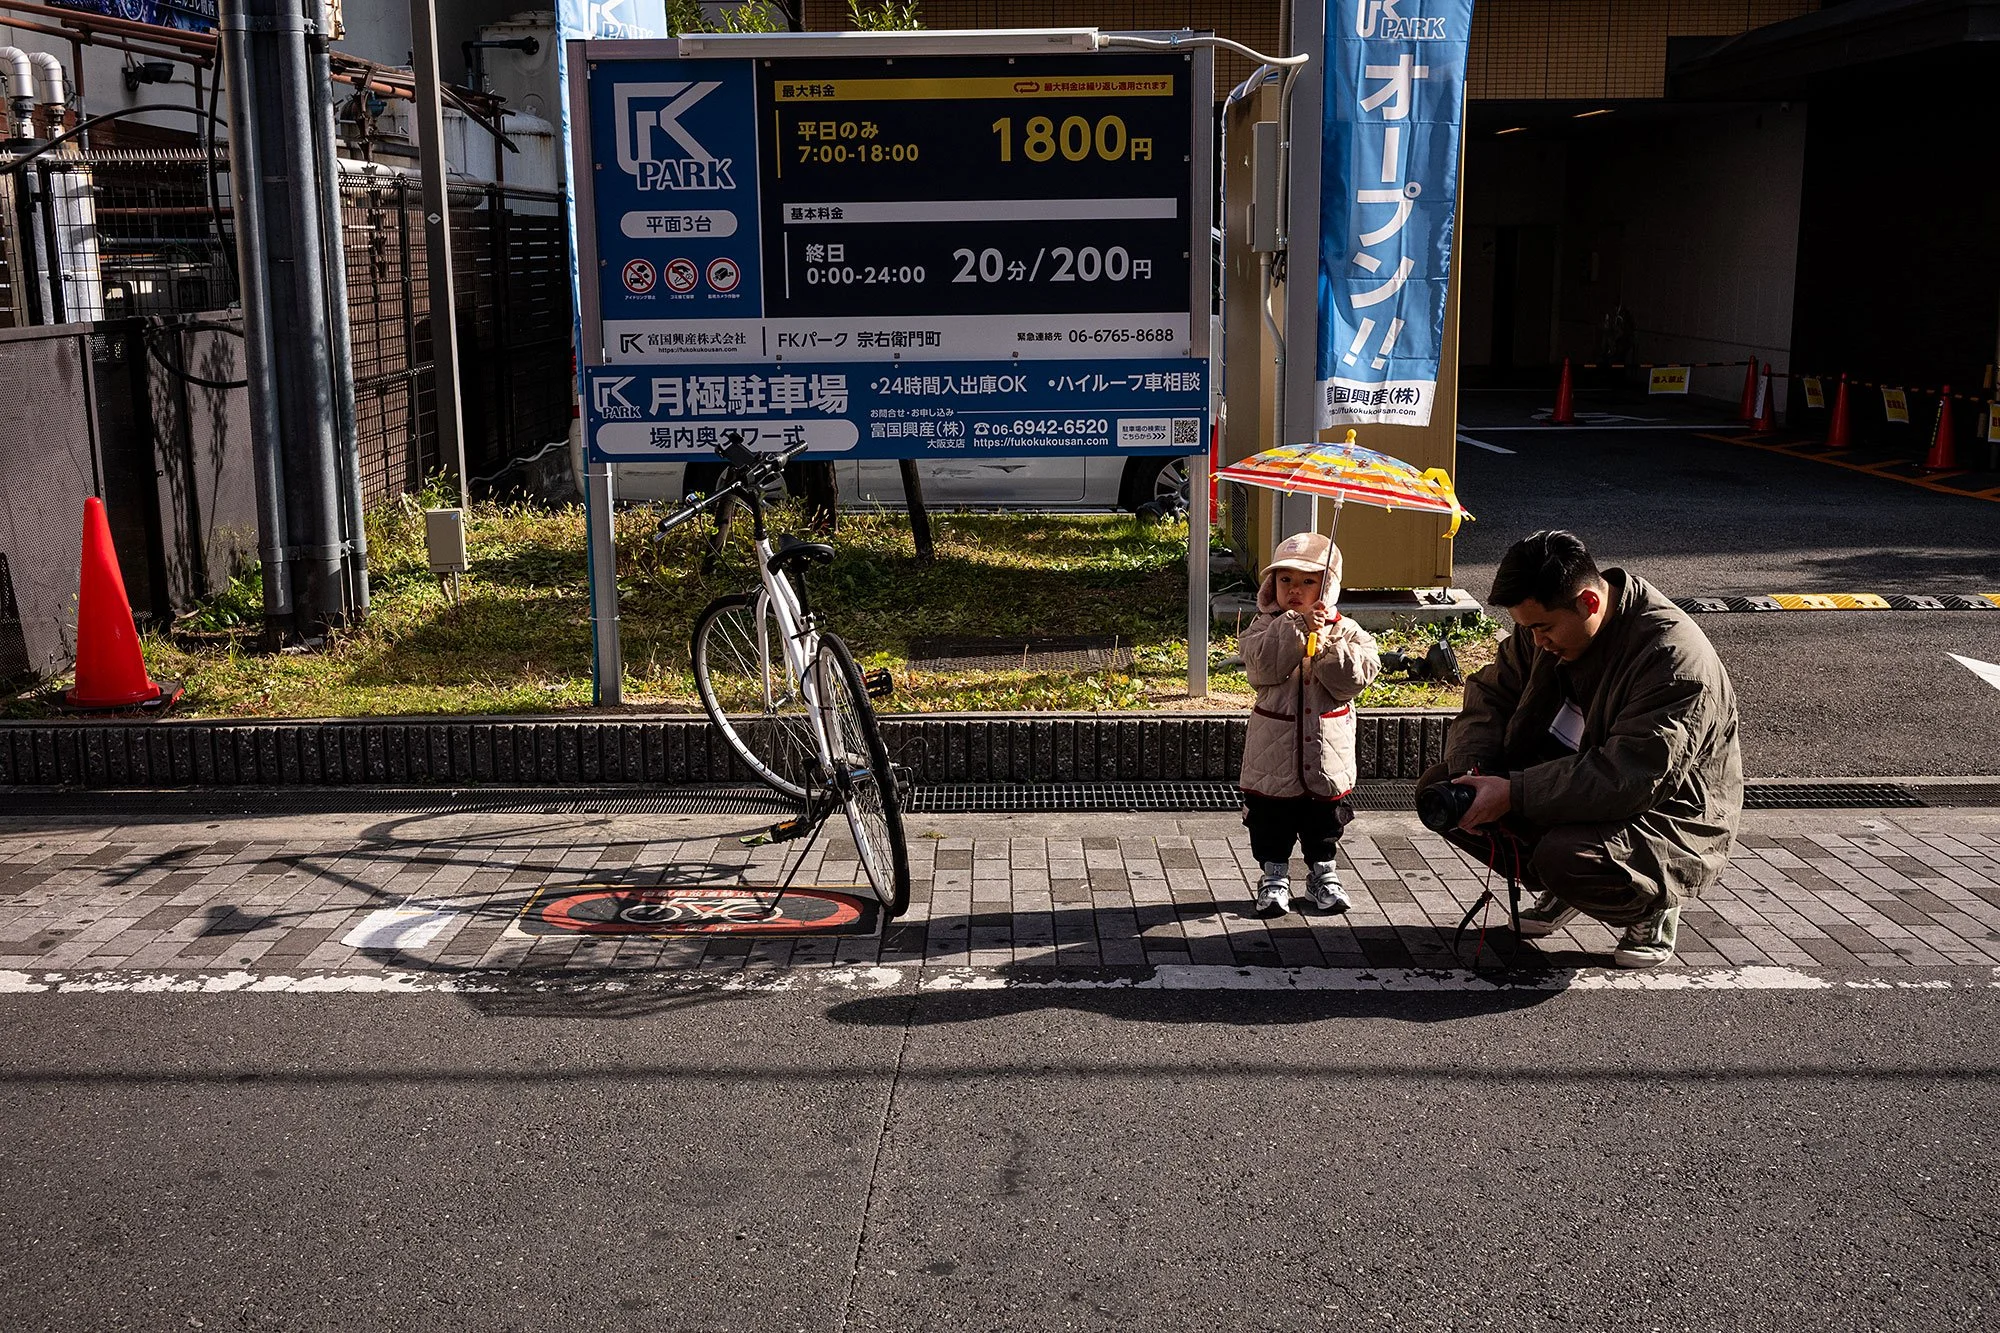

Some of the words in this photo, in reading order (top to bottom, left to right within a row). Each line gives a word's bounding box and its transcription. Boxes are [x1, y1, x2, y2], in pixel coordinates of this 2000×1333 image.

[1381, 18, 1446, 39] PARK
[782, 84, 835, 97] 最大料金
[798, 121, 879, 141] 平日のみ
[993, 115, 1152, 162] 1800円
[798, 144, 919, 163] 7:00-18:00
[637, 158, 736, 190] PARK
[791, 207, 843, 220] 基本料金
[646, 215, 712, 233] 平面3台
[806, 243, 844, 263] 終日
[952, 246, 1152, 283] 20分/200円
[807, 266, 926, 285] 0:00-24:00
[648, 333, 746, 346] 富国興産株式会社
[778, 331, 848, 347] FKパーク
[857, 331, 941, 347] 宗右衛門町
[1017, 332, 1062, 341] 緊急連絡先
[1069, 328, 1174, 342] 06-6765-8688
[658, 346, 738, 354] https://fukokukousan.com
[649, 374, 848, 416] 月極駐車場
[602, 405, 642, 419] PARK
[870, 408, 954, 418] お問合せ・お申し込み
[650, 425, 805, 448] 場内奥タワー式
[870, 421, 965, 438] 富国興産(株)
[992, 418, 1108, 435] 06-6942-6520
[927, 438, 965, 448] 大阪支店
[973, 437, 1108, 449] https://fukokukousan.com
